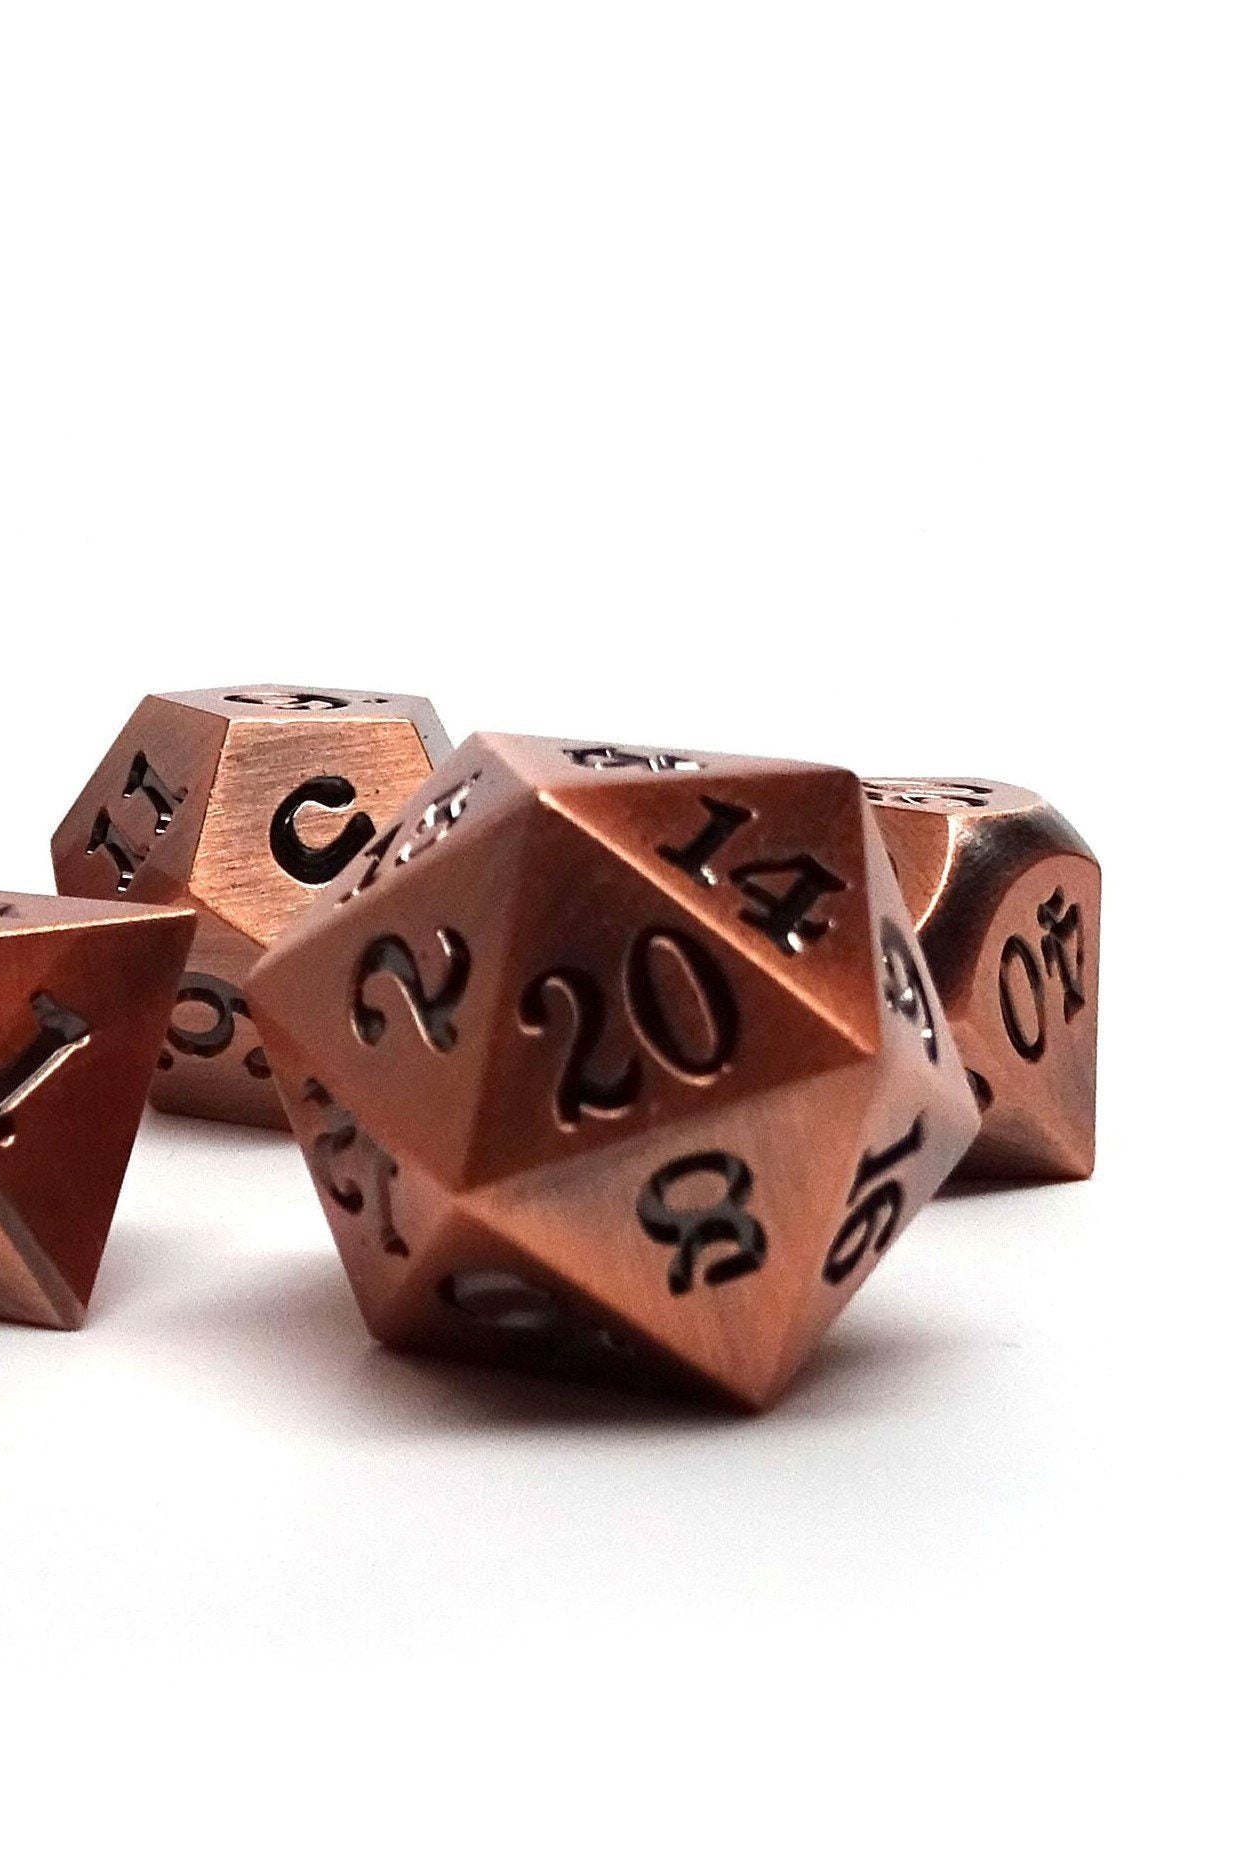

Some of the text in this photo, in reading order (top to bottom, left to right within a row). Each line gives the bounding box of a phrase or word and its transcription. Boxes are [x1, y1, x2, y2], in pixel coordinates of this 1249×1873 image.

[87, 751, 189, 892] 11
[657, 795, 851, 955] 14
[351, 927, 471, 1055] 2
[517, 925, 738, 1132] 20
[636, 1150, 768, 1296] 8
[821, 1110, 925, 1286] 16
